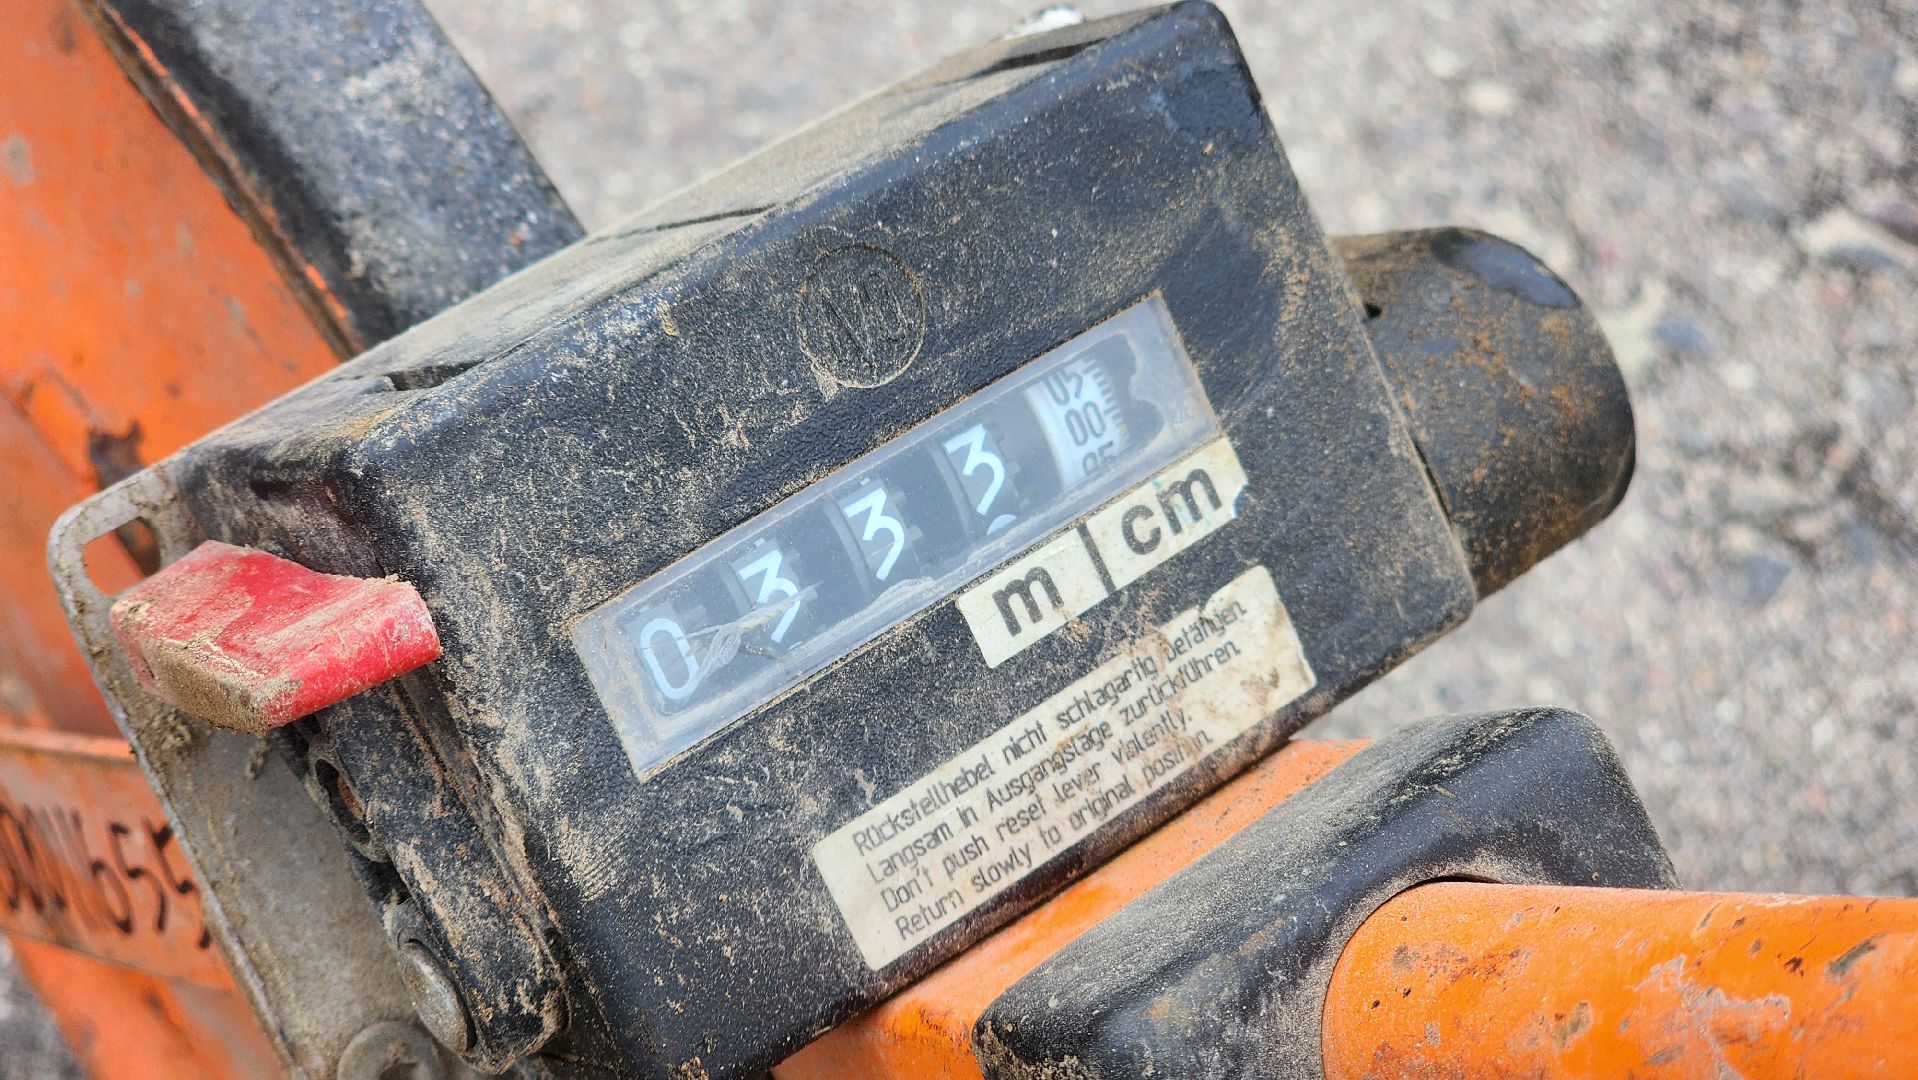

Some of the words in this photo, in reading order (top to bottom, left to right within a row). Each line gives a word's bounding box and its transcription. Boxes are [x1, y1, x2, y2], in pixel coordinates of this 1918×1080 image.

[1064, 400, 1106, 447] 00
[992, 566, 1065, 637] m
[1121, 468, 1223, 555] cm
[852, 754, 996, 857] Rückstellhebel
[1002, 720, 1048, 765] nicht
[1056, 654, 1159, 730] schlagartig
[867, 821, 954, 884] Langsam
[956, 804, 979, 828] in
[985, 720, 1114, 813] Ausgangslage
[880, 864, 934, 912] Don't
[942, 834, 990, 881] push
[995, 795, 1048, 842] reset
[1052, 762, 1102, 804] lever
[895, 888, 965, 941] Return
[970, 843, 1034, 894] slowly
[1040, 825, 1062, 849] to
[1068, 774, 1136, 831] original
